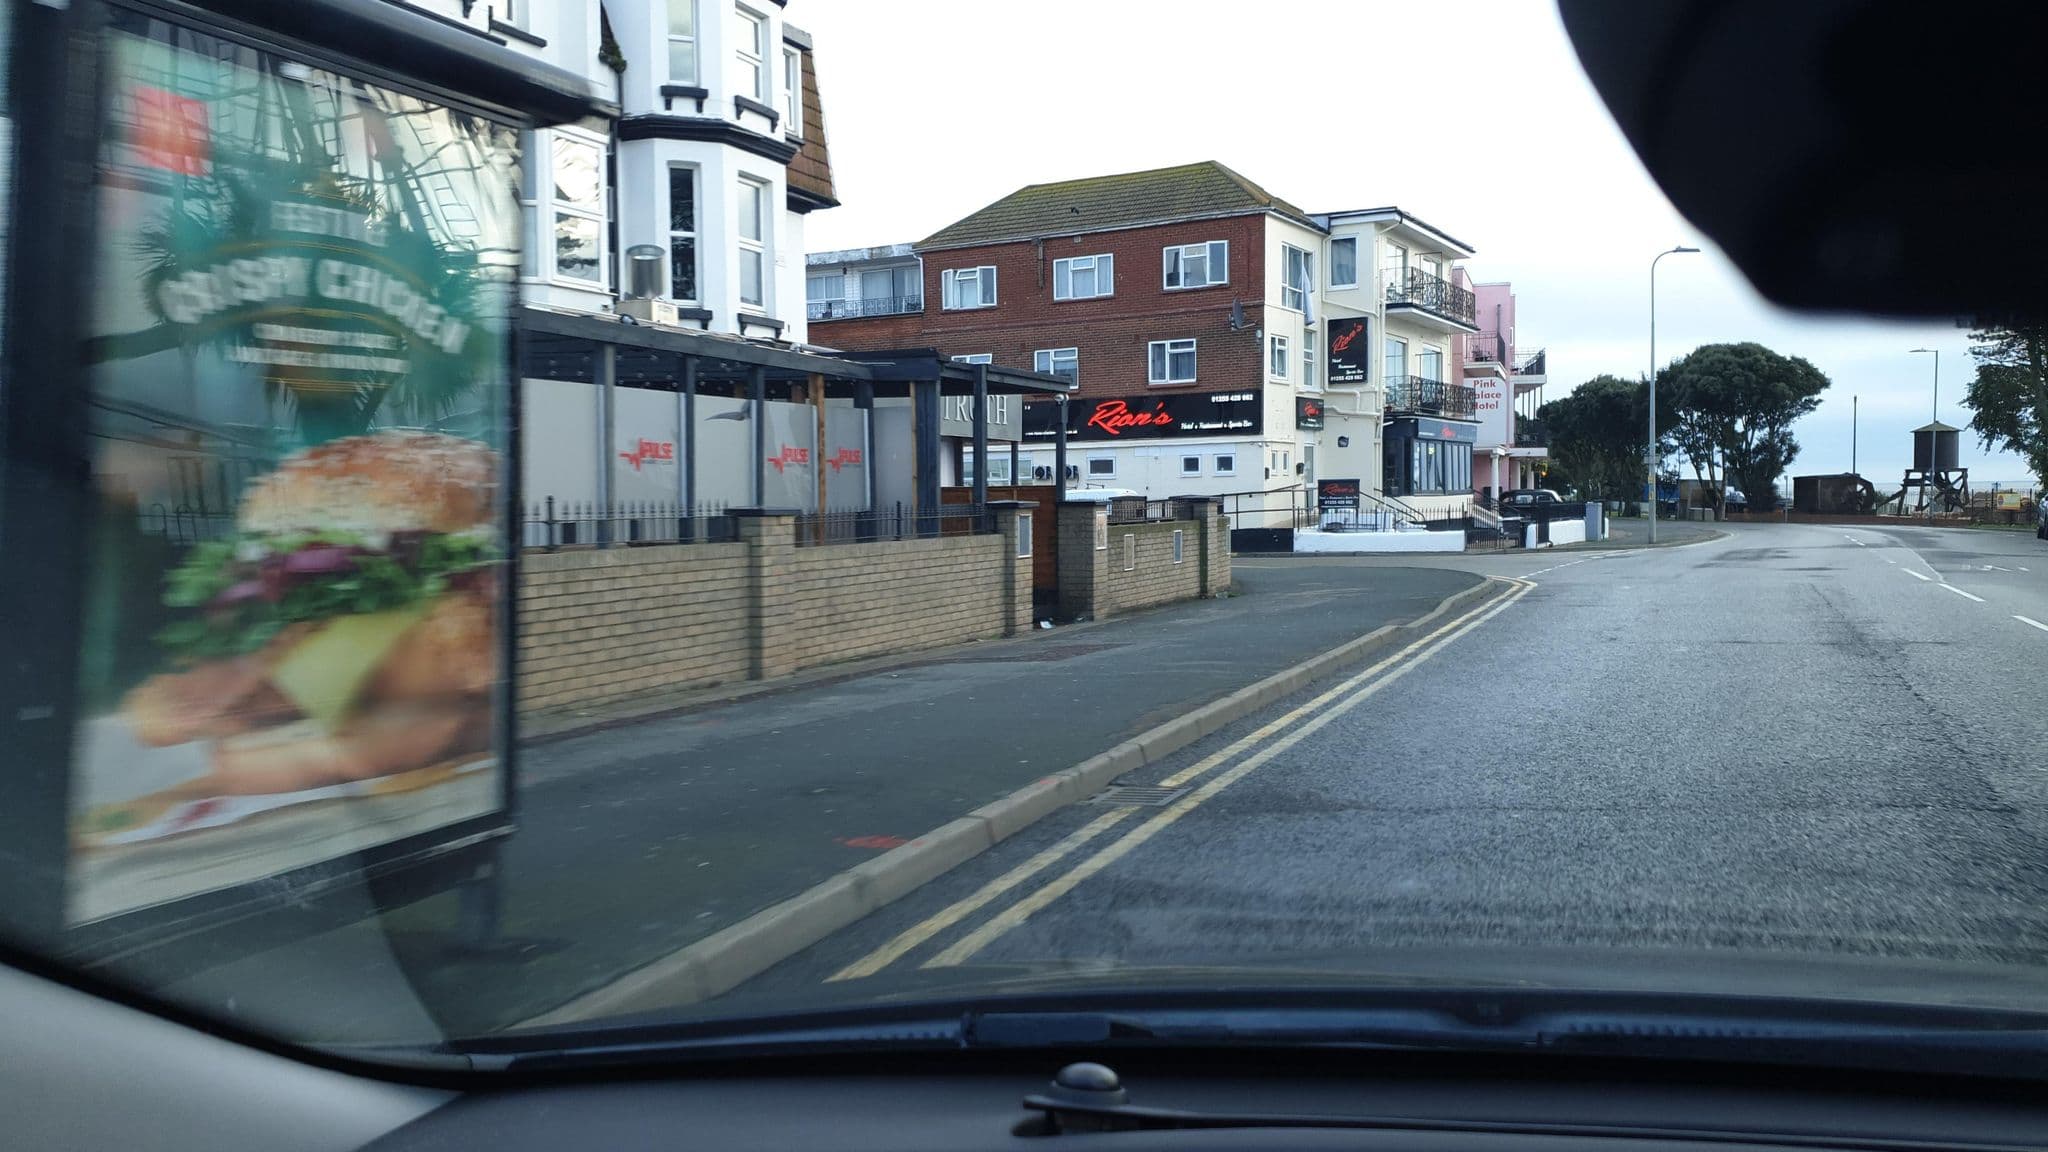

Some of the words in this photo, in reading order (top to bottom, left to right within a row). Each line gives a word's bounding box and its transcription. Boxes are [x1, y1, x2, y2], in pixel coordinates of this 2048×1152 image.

[316, 257, 471, 355] CHICKEN
[1473, 379, 1496, 388] Pink
[1088, 400, 1173, 434] Rion's
